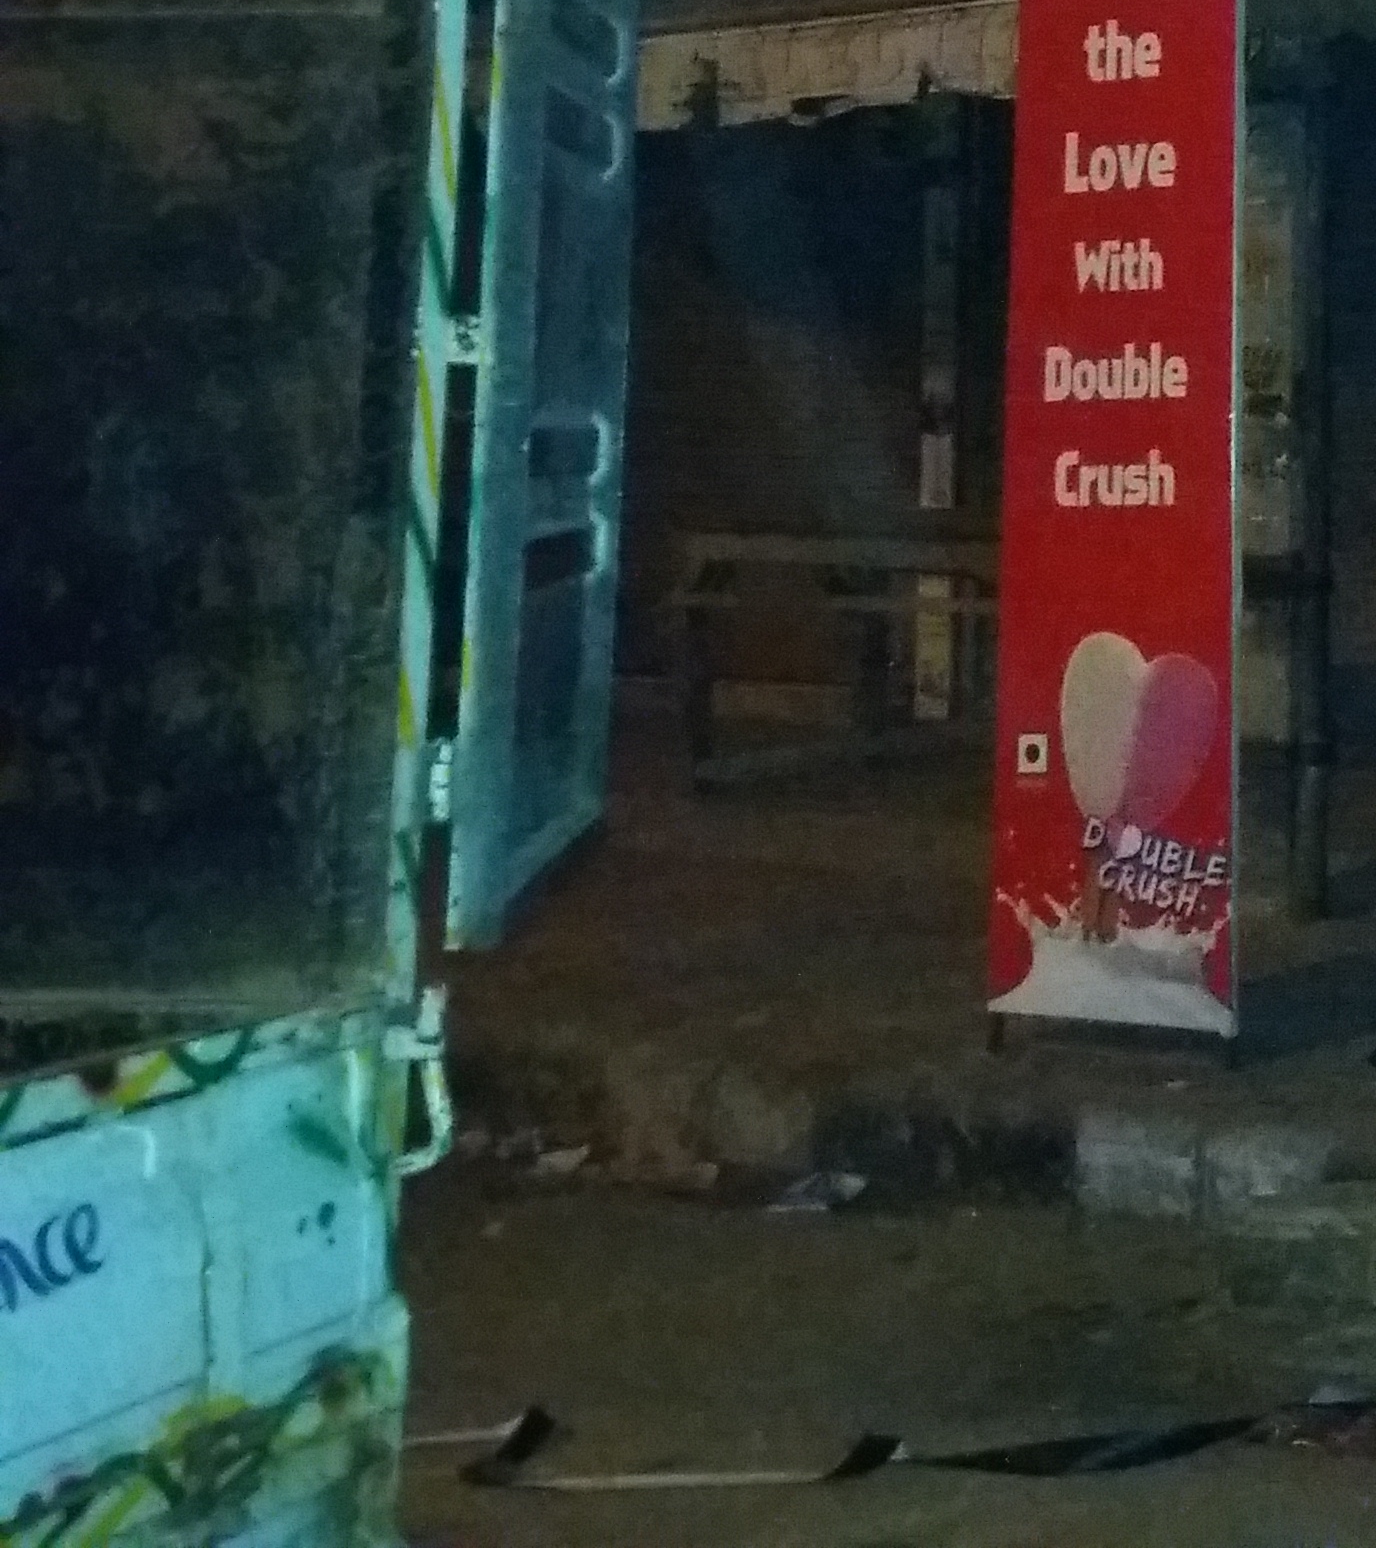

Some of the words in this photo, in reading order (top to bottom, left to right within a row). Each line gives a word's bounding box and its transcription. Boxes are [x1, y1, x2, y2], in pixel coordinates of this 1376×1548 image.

[1082, 18, 1163, 84] the
[1063, 130, 1178, 194] Love
[1073, 237, 1165, 294] With
[1043, 340, 1190, 403] Double
[1053, 444, 1176, 508] Crush
[1098, 860, 1202, 918] CRUSH
